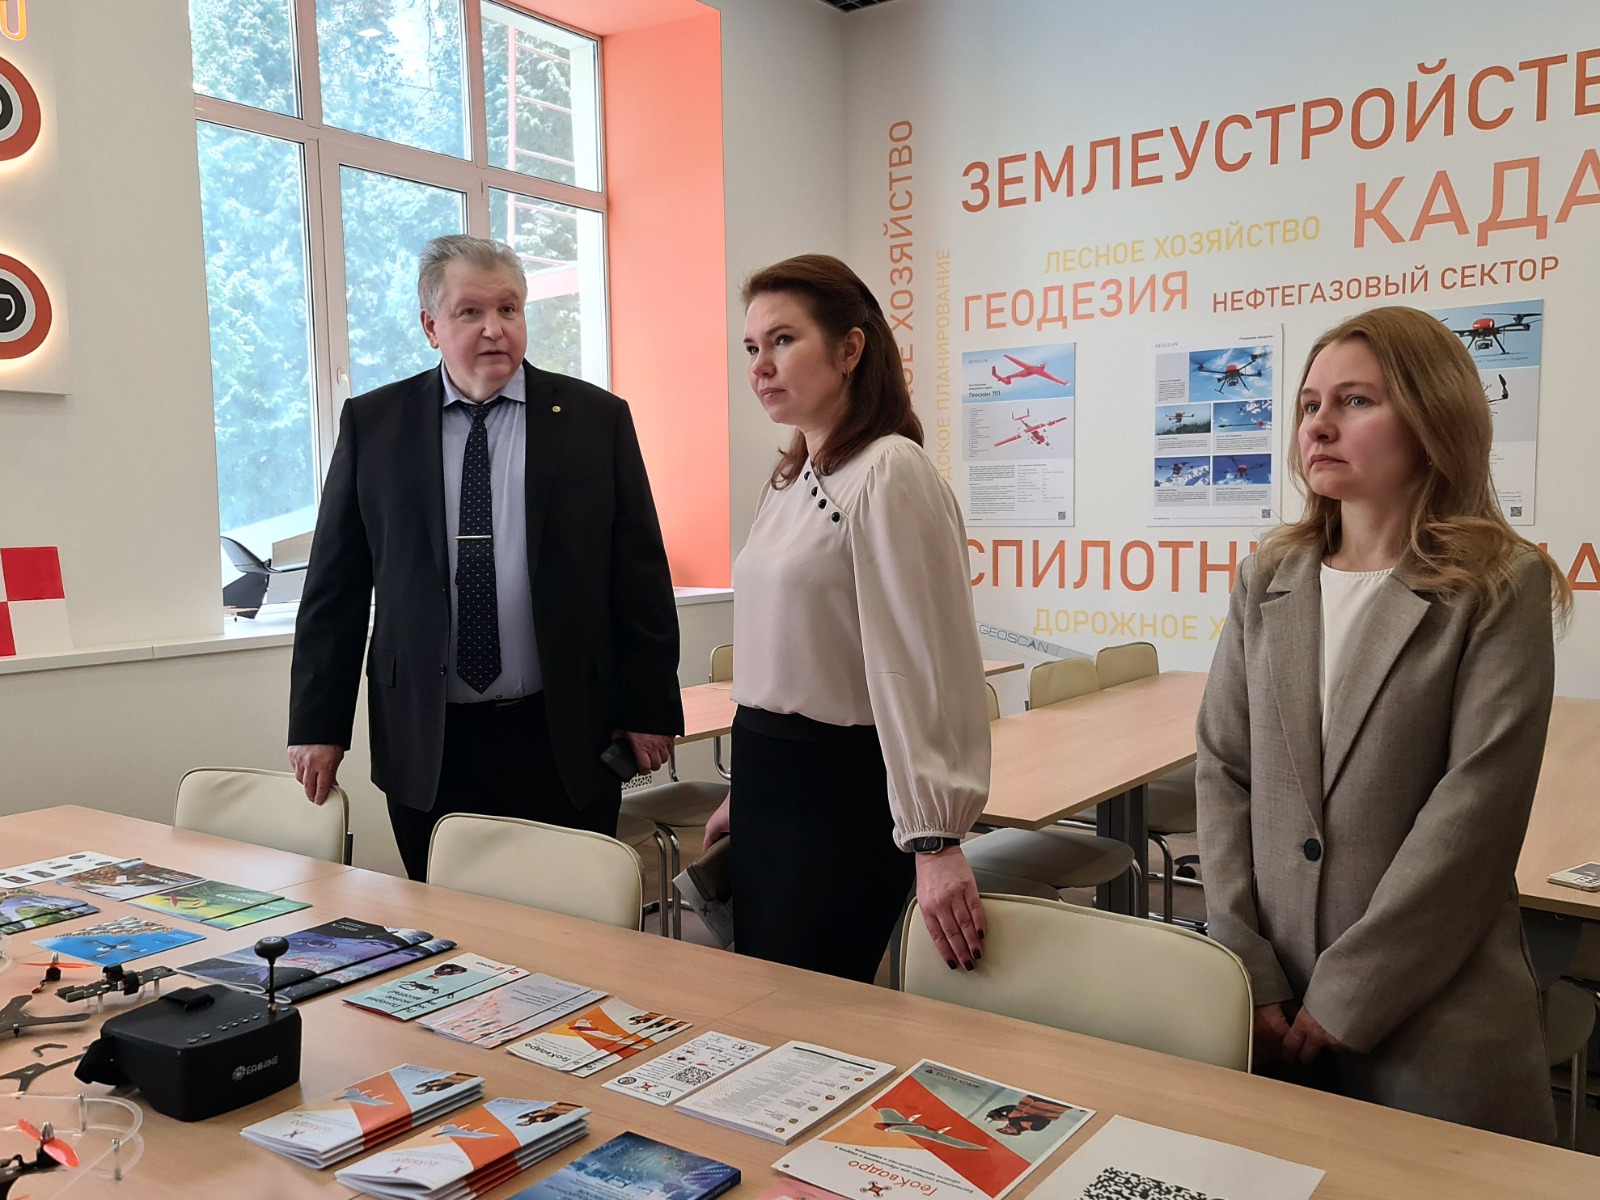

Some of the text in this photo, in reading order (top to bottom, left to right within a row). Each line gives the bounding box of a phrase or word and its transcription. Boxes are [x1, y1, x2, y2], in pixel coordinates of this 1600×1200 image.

[883, 120, 914, 332] ХОЗЯЙСТВО
[1043, 216, 1321, 275] ЛЕСНОЕ ХОЗЯЙСТВО
[963, 270, 1189, 332] ГЕОДЕЗИЯ
[1212, 256, 1560, 313] НЕФТЕГАЗОВЫЙ СЕКТОР
[936, 248, 951, 411] ПЛАНИРОВАНИЕ
[967, 538, 1257, 594] СПИЛОТН
[978, 623, 1049, 654] GEOSCAN
[1032, 609, 1198, 640] ДОРОЖНОЕ
[848, 1160, 938, 1196] ГеоКвадро
